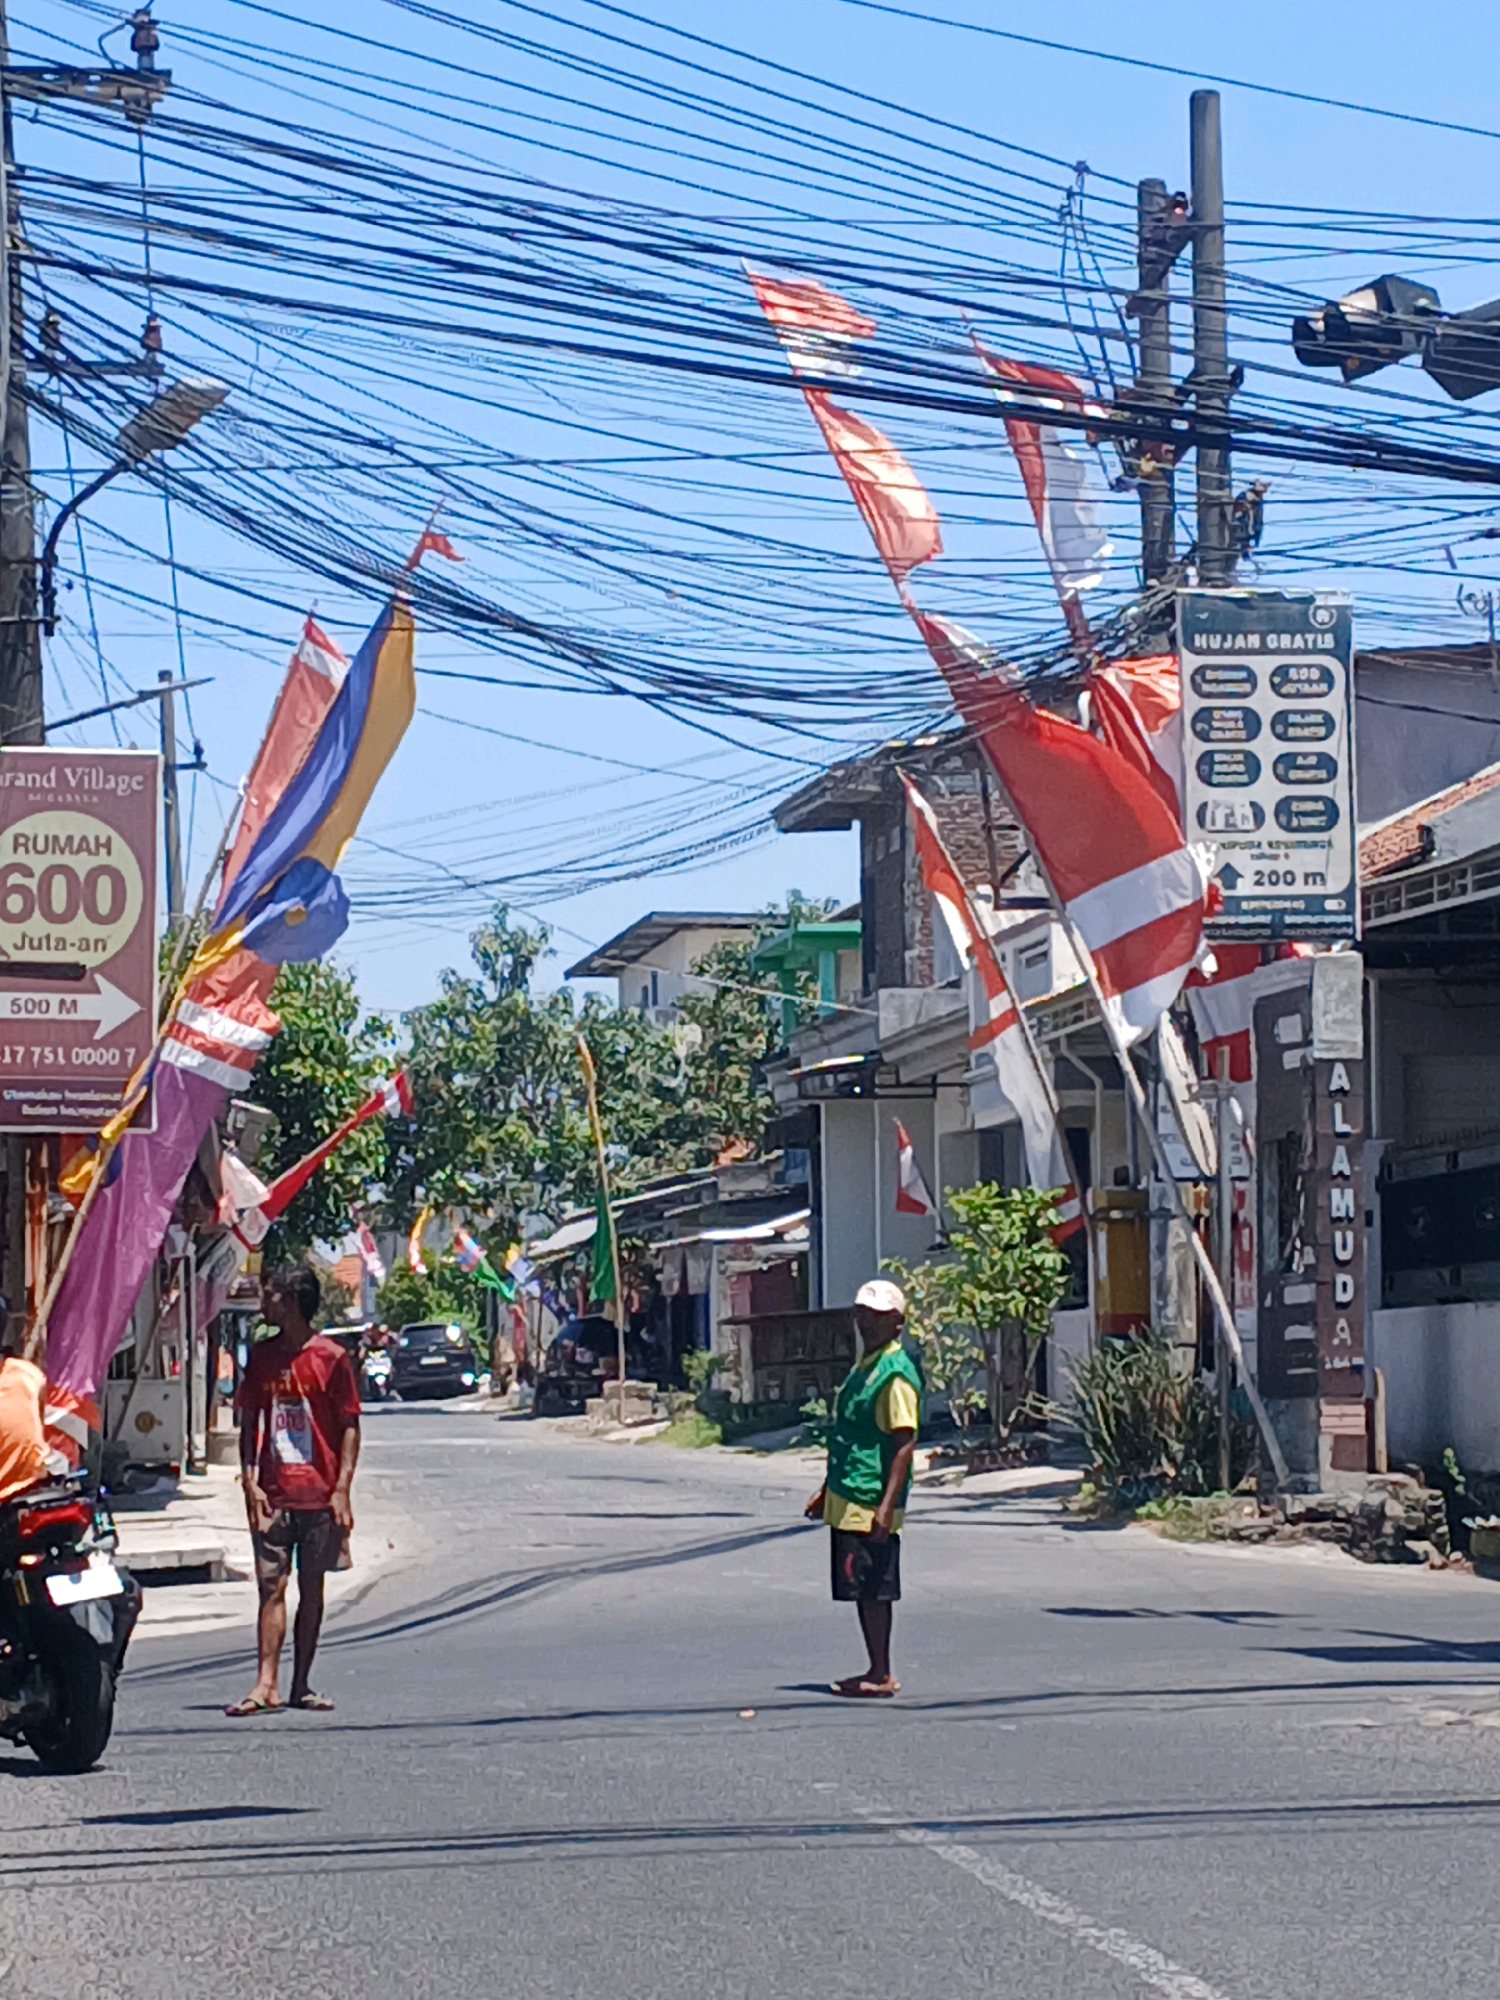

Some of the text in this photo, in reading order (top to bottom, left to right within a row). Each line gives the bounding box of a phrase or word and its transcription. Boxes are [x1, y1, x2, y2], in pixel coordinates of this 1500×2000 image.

[0, 766, 144, 797] rand Village
[12, 833, 113, 857] RUMAH
[1253, 869, 1326, 887] 200 m
[0, 862, 128, 926] 600
[10, 998, 78, 1015] 500 M
[0, 1045, 136, 1068] 17 751 0000 7
